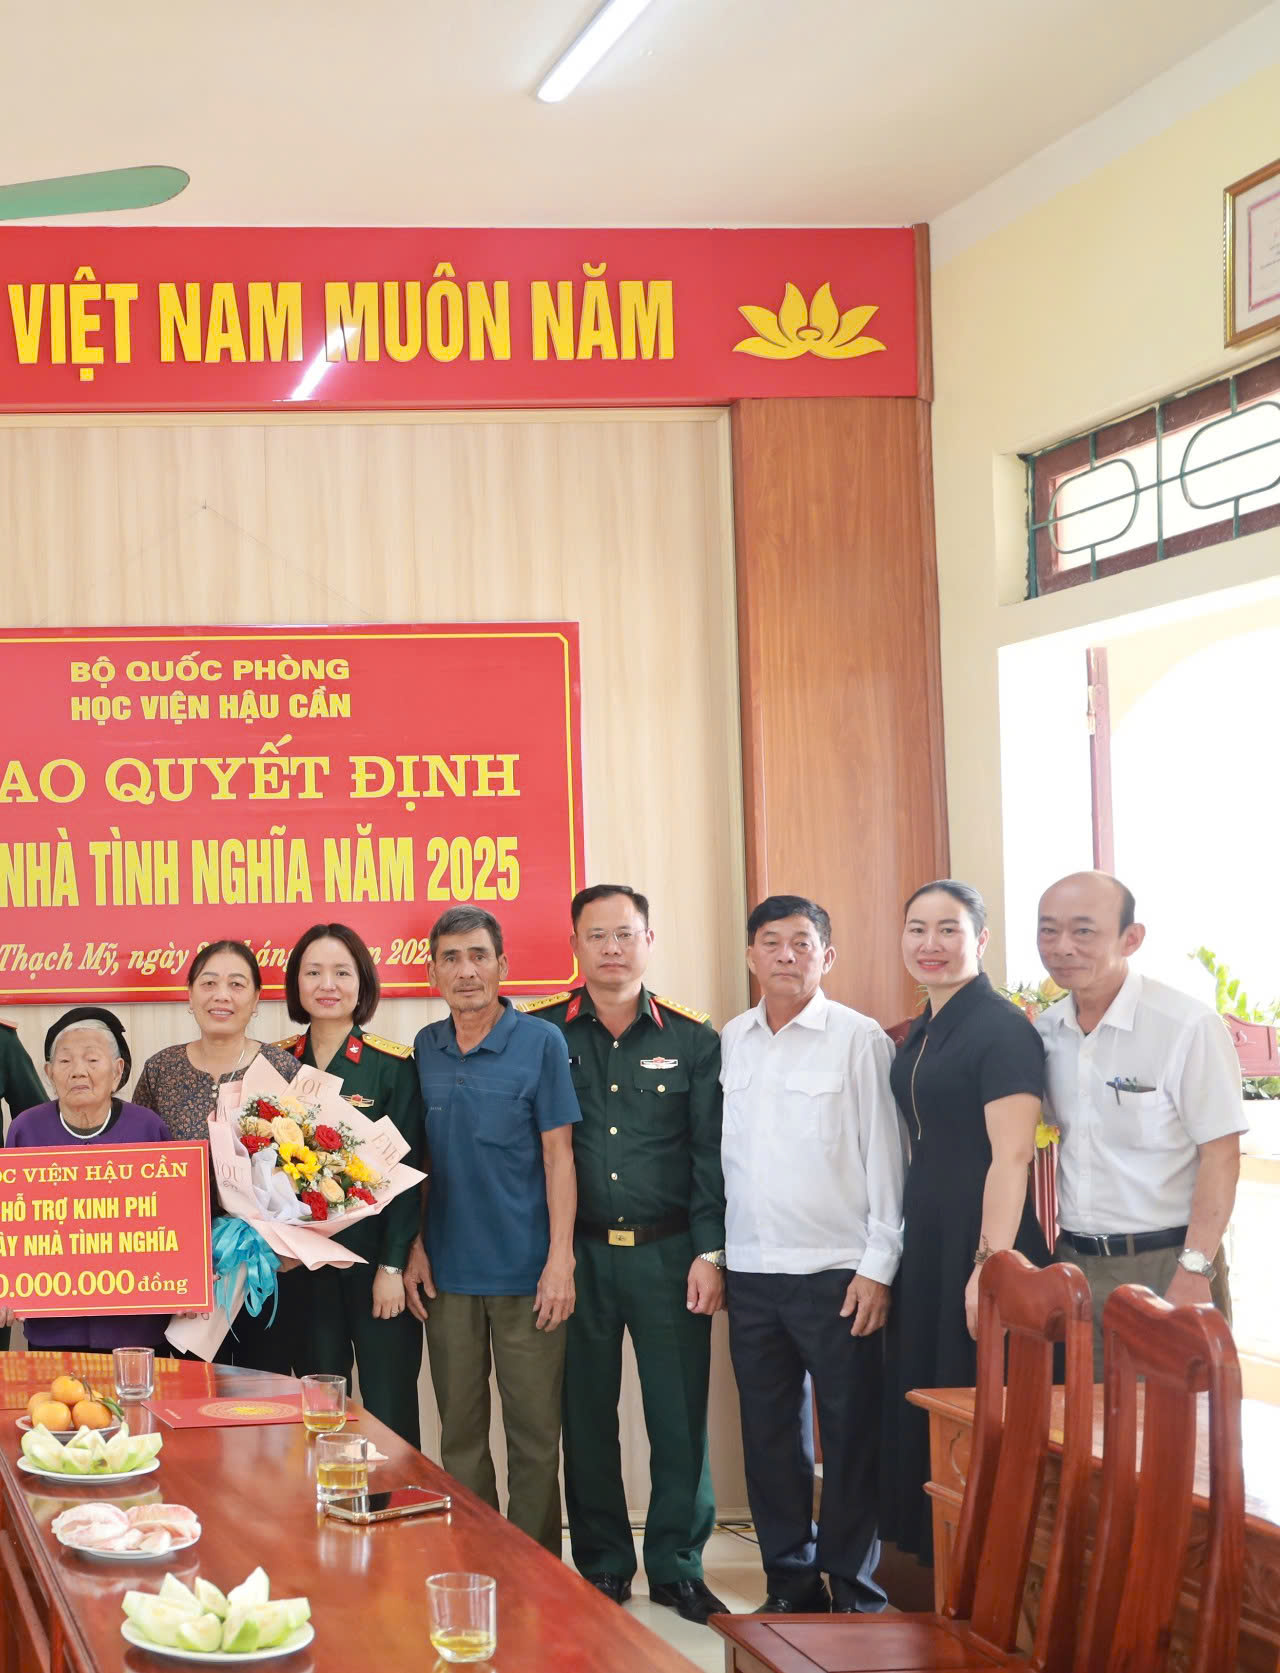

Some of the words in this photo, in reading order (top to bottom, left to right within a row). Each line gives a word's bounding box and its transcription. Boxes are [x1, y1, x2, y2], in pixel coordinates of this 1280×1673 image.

[8, 266, 138, 381] VIỆT
[159, 281, 303, 363] NAM
[325, 262, 511, 363] MUÔN
[531, 262, 674, 361] NĂM
[71, 655, 116, 689] BỘ
[126, 651, 222, 682] QUỐC
[233, 654, 350, 681] PHÒNG
[71, 696, 132, 726] HỌC
[140, 690, 210, 725] VIỆN
[219, 689, 280, 724] HẬU
[289, 685, 351, 718] CẦN
[105, 734, 331, 806] QUYẾT
[350, 753, 521, 812] ĐỊNH
[88, 826, 180, 906] TÌNH
[192, 825, 314, 905] NGHĨA
[324, 823, 415, 904] NĂM
[426, 836, 521, 902] 2025
[77, 941, 121, 976] Mỹ,
[127, 940, 190, 975] ngày
[384, 938, 433, 965] 202
[23, 1162, 78, 1186] VIỆN
[85, 1160, 133, 1184] HẬU
[141, 1154, 188, 1179] CẦN
[0, 1192, 27, 1223] HỖ
[31, 1196, 68, 1225] TRỢ
[73, 1197, 120, 1220] KINH
[125, 1191, 158, 1218] PHÍ
[24, 1229, 64, 1257] NHÀ
[69, 1228, 113, 1255] TÌNH
[119, 1226, 179, 1254] NGHĨA
[137, 1271, 188, 1295] đồng
